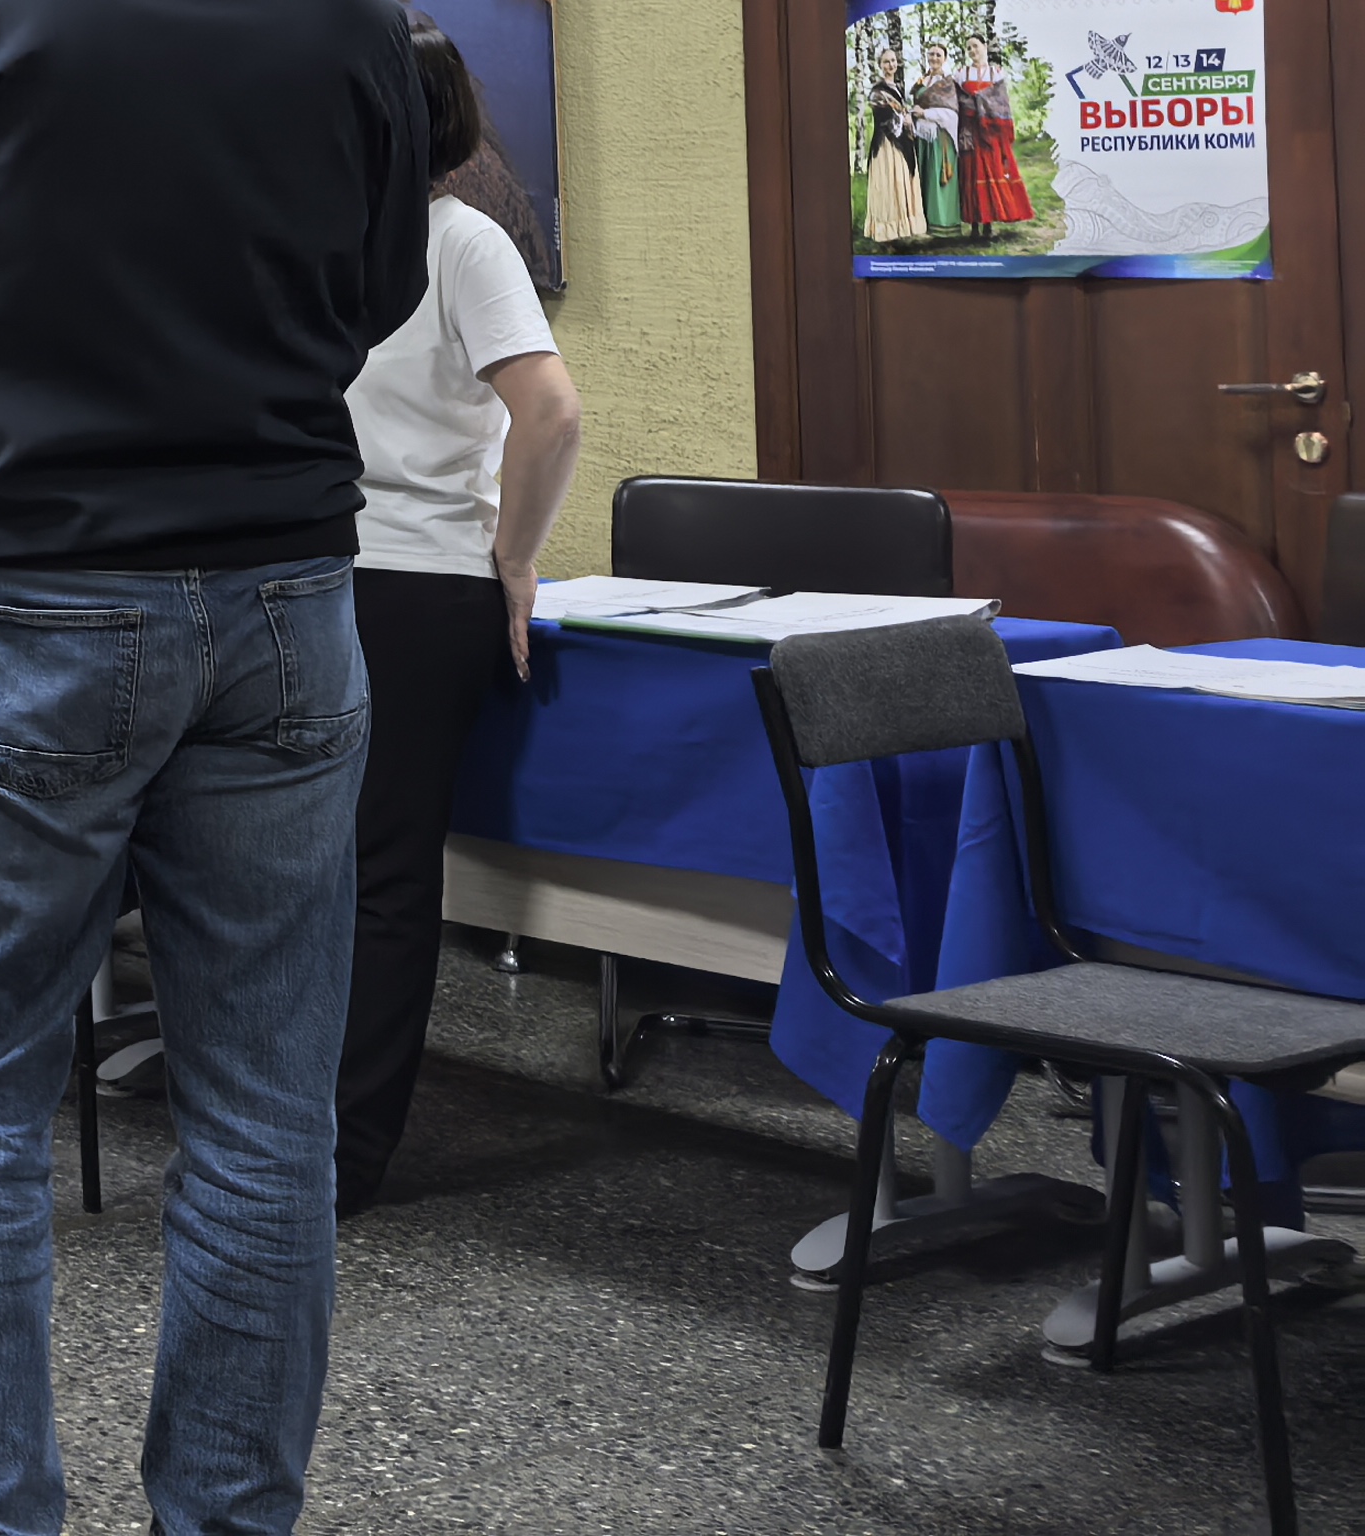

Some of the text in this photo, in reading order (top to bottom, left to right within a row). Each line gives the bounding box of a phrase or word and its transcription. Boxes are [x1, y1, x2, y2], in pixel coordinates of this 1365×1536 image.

[1145, 53, 1220, 69] 12 13 14
[1147, 74, 1249, 92] СЕНТЯБРЯ
[1080, 96, 1255, 130] ВЫБОРЫ
[1080, 132, 1256, 152] РЕСПУБЛИКИ КОМИ
